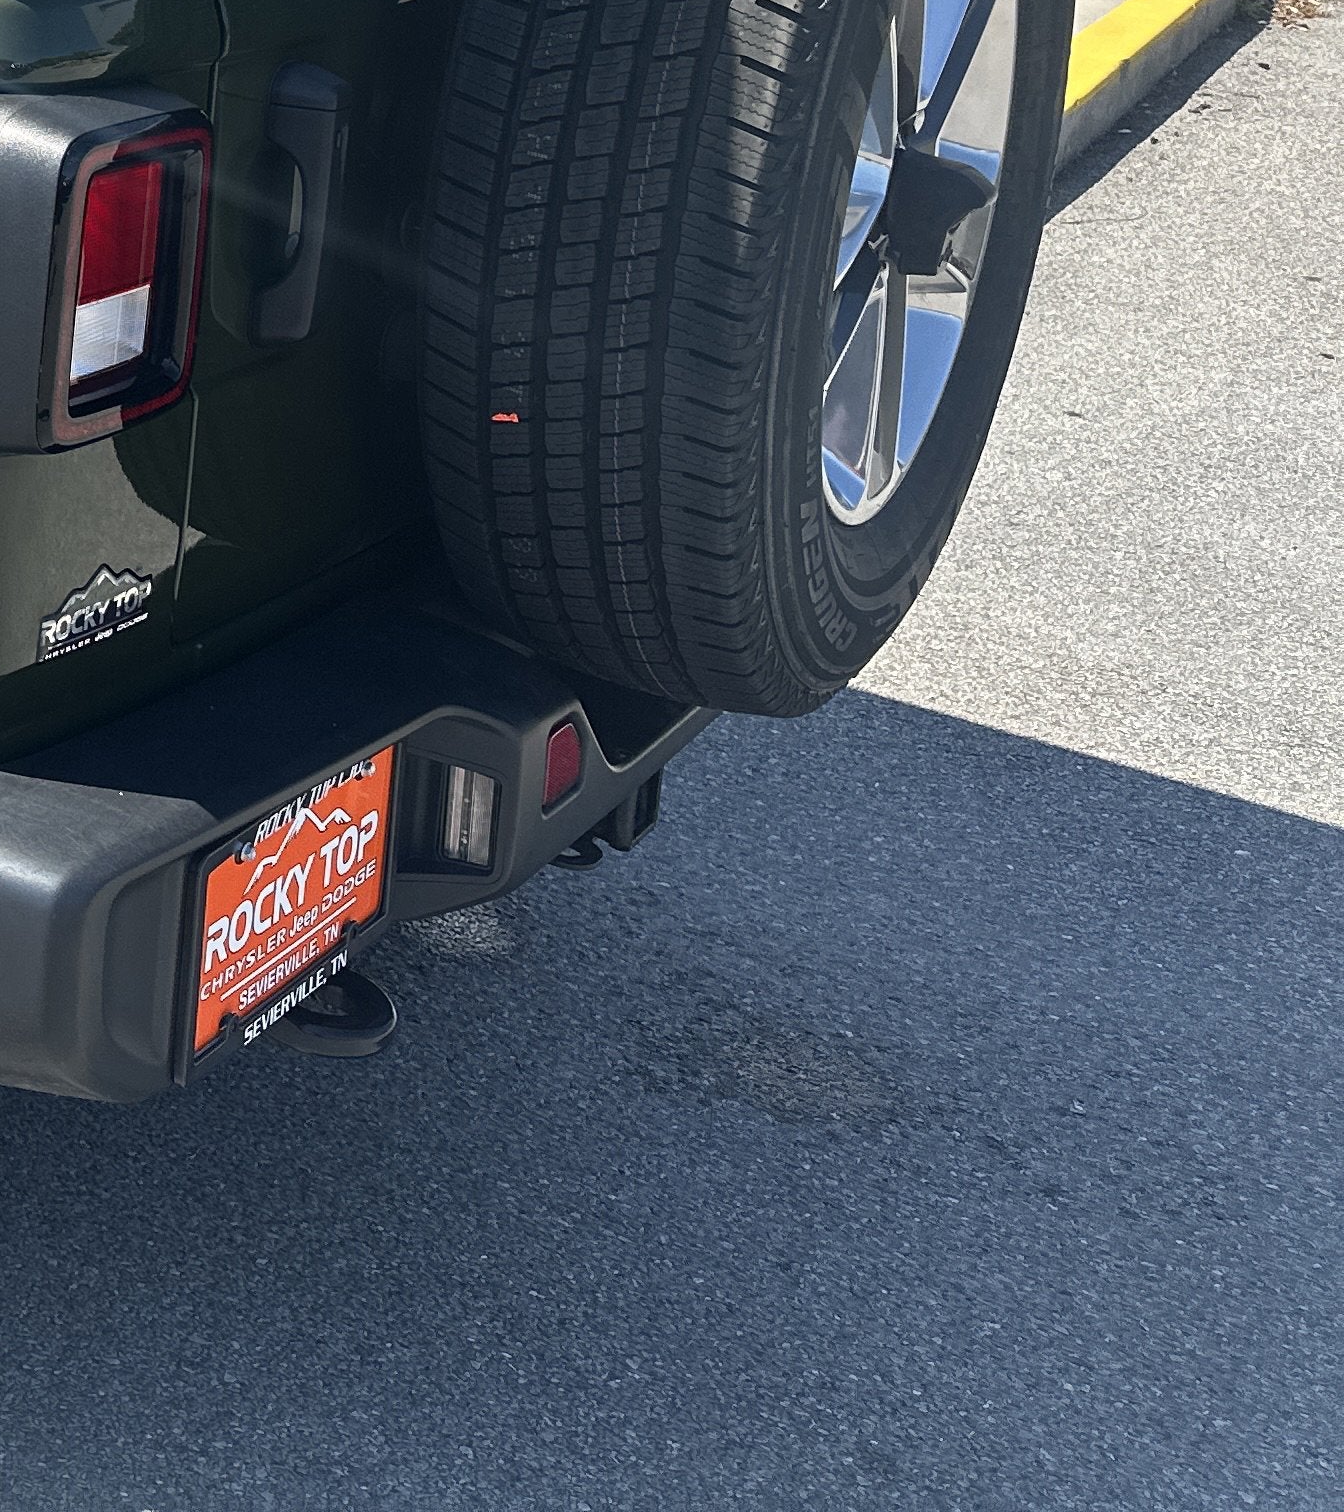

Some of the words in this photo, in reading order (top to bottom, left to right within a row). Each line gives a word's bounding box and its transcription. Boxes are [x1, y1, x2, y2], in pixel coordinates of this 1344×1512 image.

[40, 598, 111, 647] ROCKY
[114, 580, 152, 617] TOP
[800, 497, 858, 652] CRUGEN
[200, 927, 286, 1001] CHRYSLER
[289, 905, 318, 938] Jeep
[321, 859, 376, 913] DODGE
[204, 852, 315, 974] ROCKY
[320, 809, 379, 889] TOP
[238, 937, 320, 1011] SEVIERVILLE,
[323, 921, 340, 946] TN
[244, 967, 327, 1046] SEVIERVILLE,
[330, 949, 348, 977] TN
